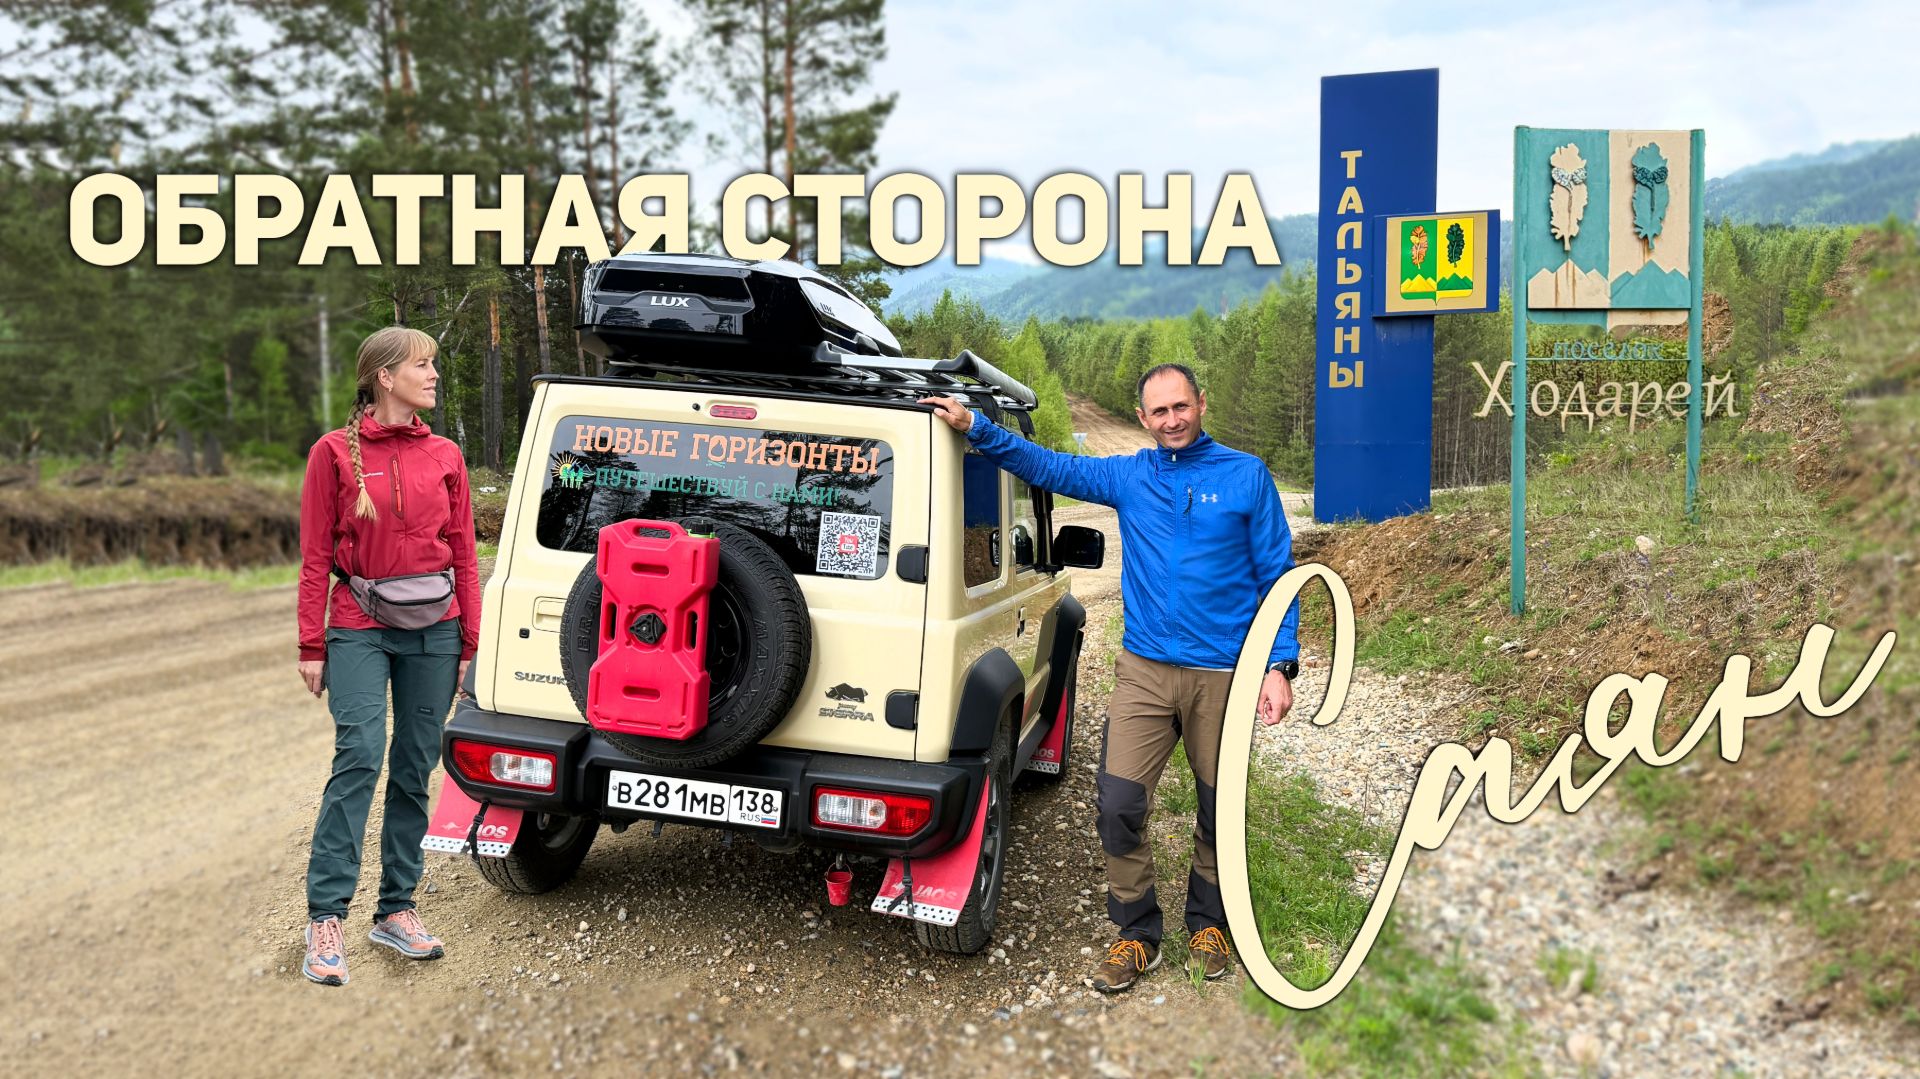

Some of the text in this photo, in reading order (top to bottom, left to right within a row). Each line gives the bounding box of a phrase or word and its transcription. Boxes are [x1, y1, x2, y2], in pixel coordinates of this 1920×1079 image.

[1328, 150, 1364, 388] ТАЛЬЯНЫ
[650, 296, 690, 308] LUX
[1471, 361, 1741, 435] Ходарей
[573, 424, 881, 475] НОВЫЕ ГОРИЗОНТЫ
[594, 467, 748, 498] ПУТЕШЕСТВУЙ
[771, 482, 841, 507] НАМИ!
[514, 671, 567, 686] SUZUK
[723, 618, 768, 728] MAXXIS
[617, 778, 726, 816] В281МВ
[733, 789, 775, 815] 138
[740, 812, 761, 823] RUS
